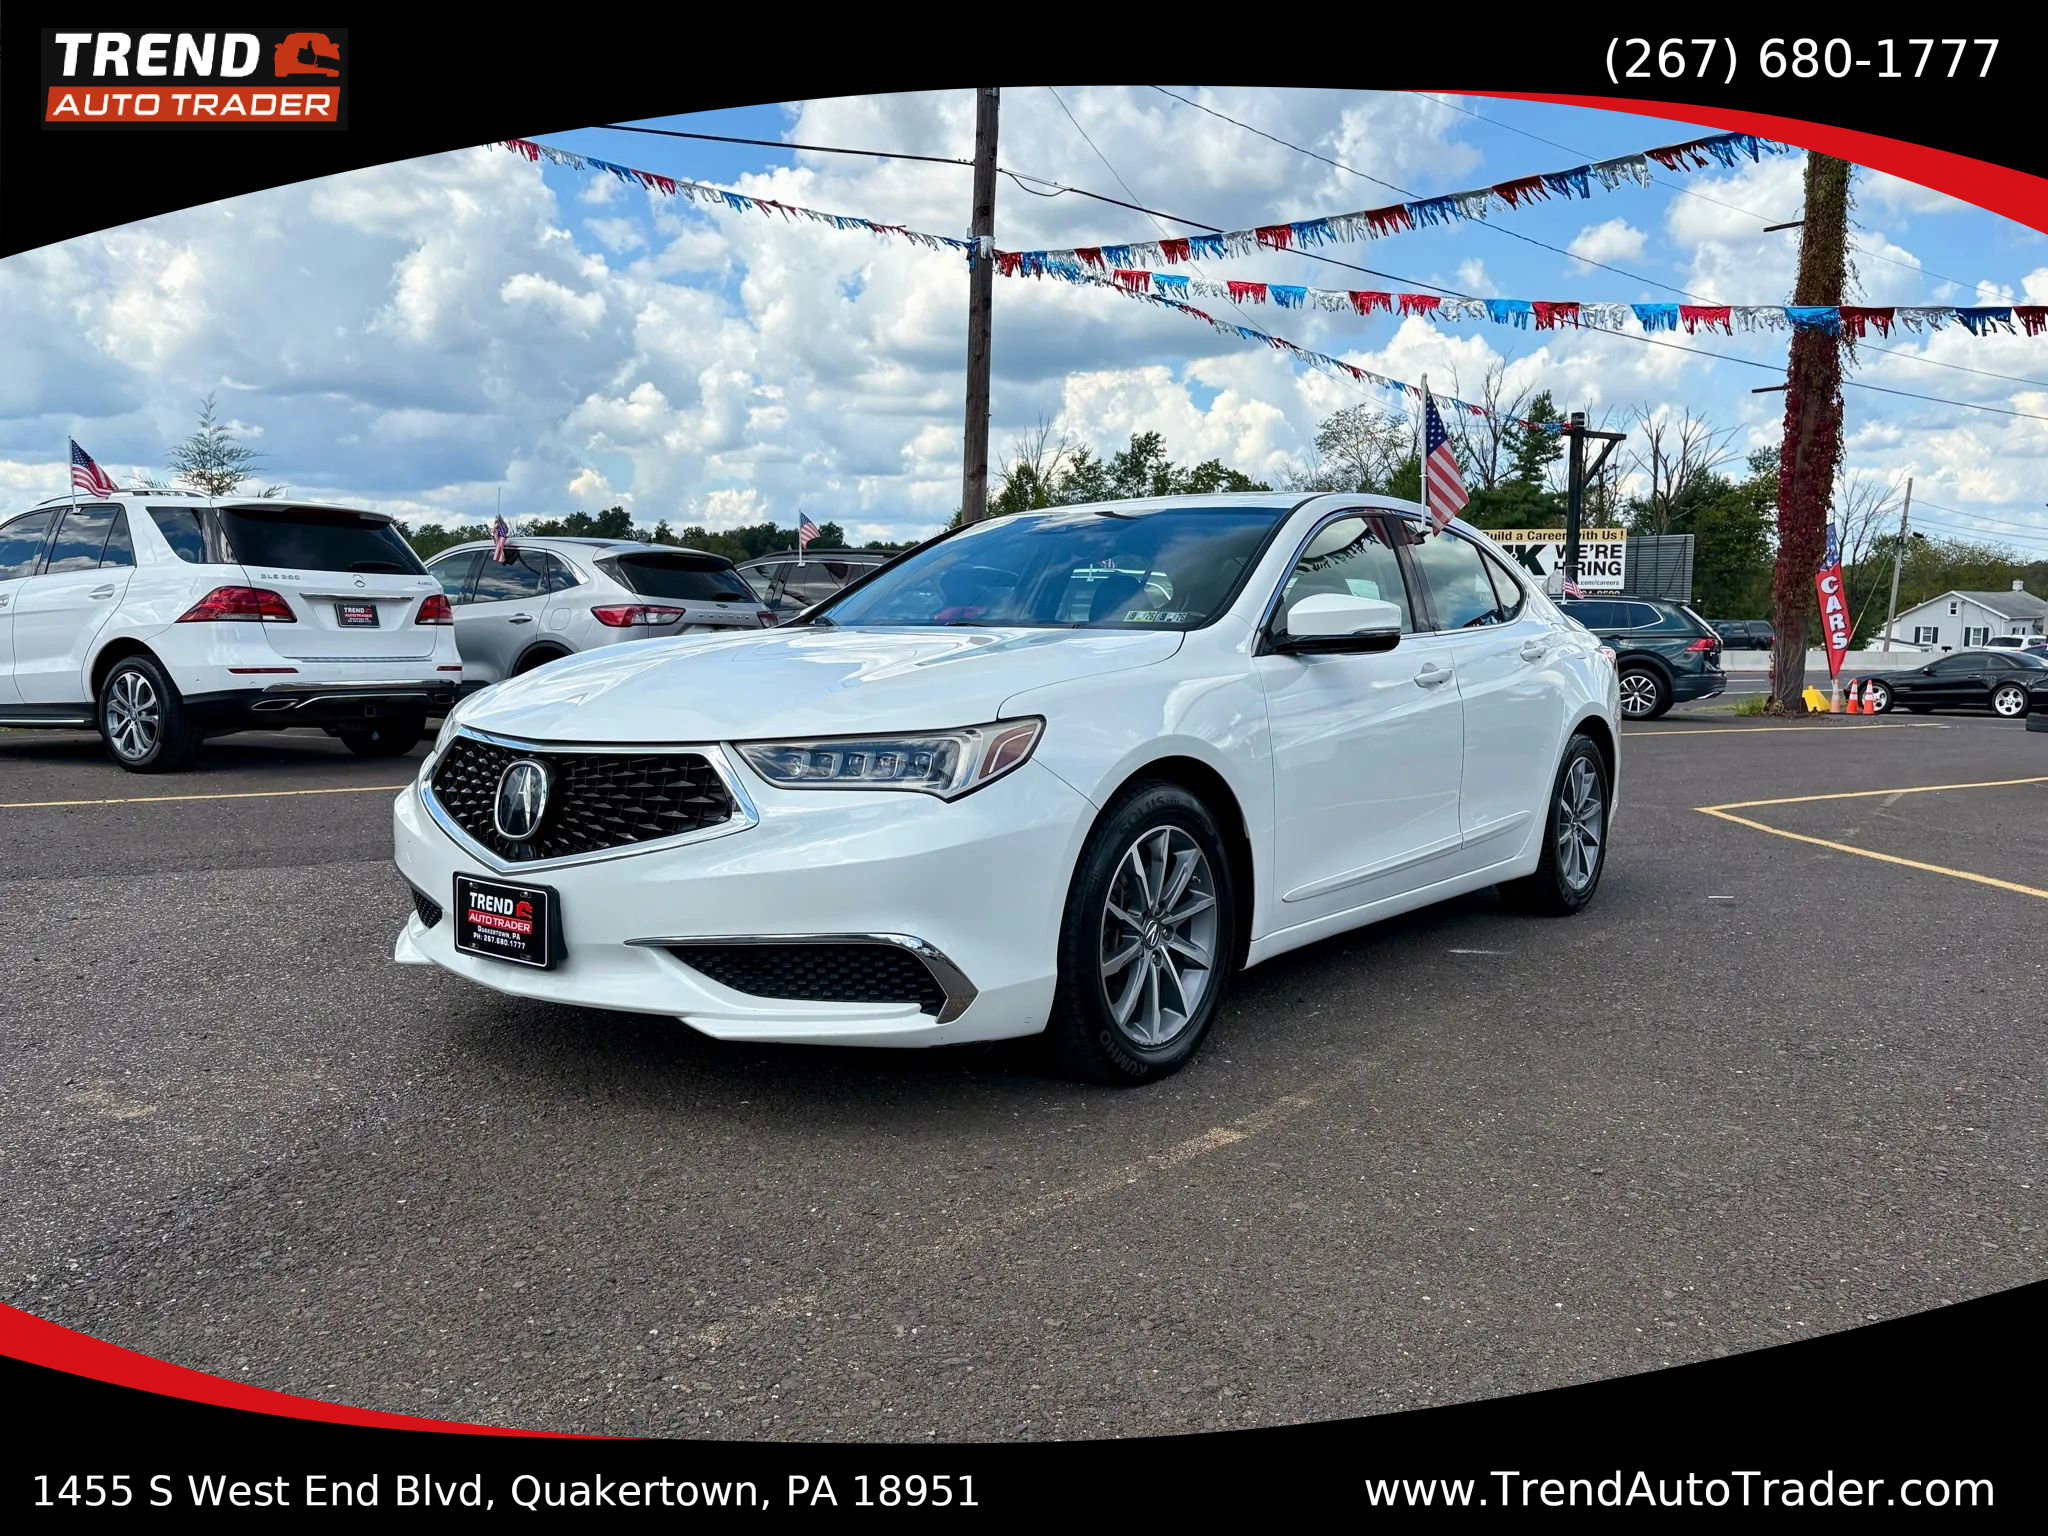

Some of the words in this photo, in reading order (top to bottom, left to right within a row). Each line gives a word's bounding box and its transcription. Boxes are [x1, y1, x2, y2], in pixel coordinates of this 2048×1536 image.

[1516, 532, 1523, 541] a
[1527, 531, 1567, 541] Career
[1579, 530, 1599, 540] ith
[1554, 561, 1622, 576] HRING
[1821, 576, 1848, 650] CARS
[469, 892, 514, 915] TREND
[469, 913, 493, 925] AUTO
[493, 917, 531, 933] TRADER
[473, 932, 483, 940] PH:
[483, 934, 526, 949] 267.680.1777
[512, 932, 521, 940] PA
